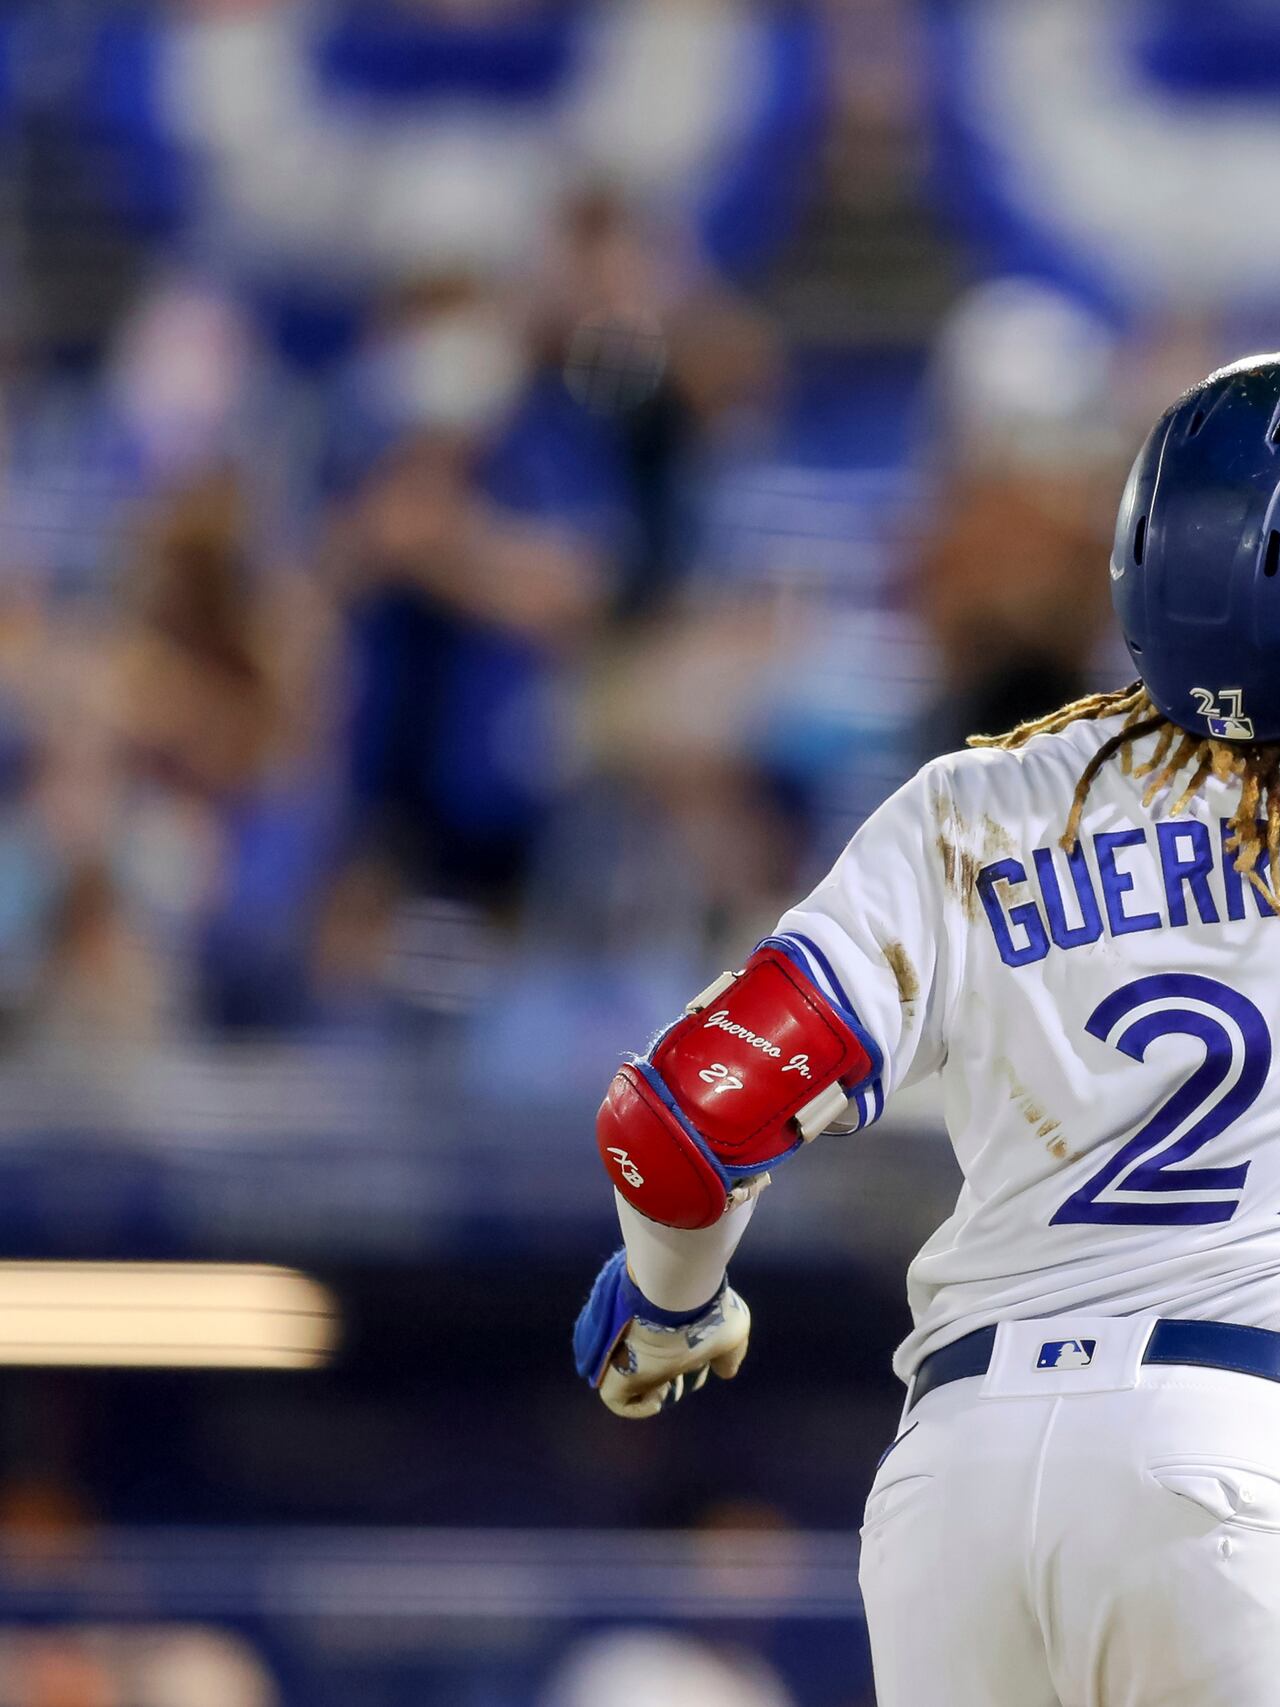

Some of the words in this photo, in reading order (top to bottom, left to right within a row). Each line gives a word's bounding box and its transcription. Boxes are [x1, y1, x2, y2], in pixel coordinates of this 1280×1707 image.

[1189, 687, 1244, 718] 27
[703, 1010, 781, 1057] Guerrero
[781, 1054, 812, 1080] Jr.
[698, 1063, 744, 1093] 27
